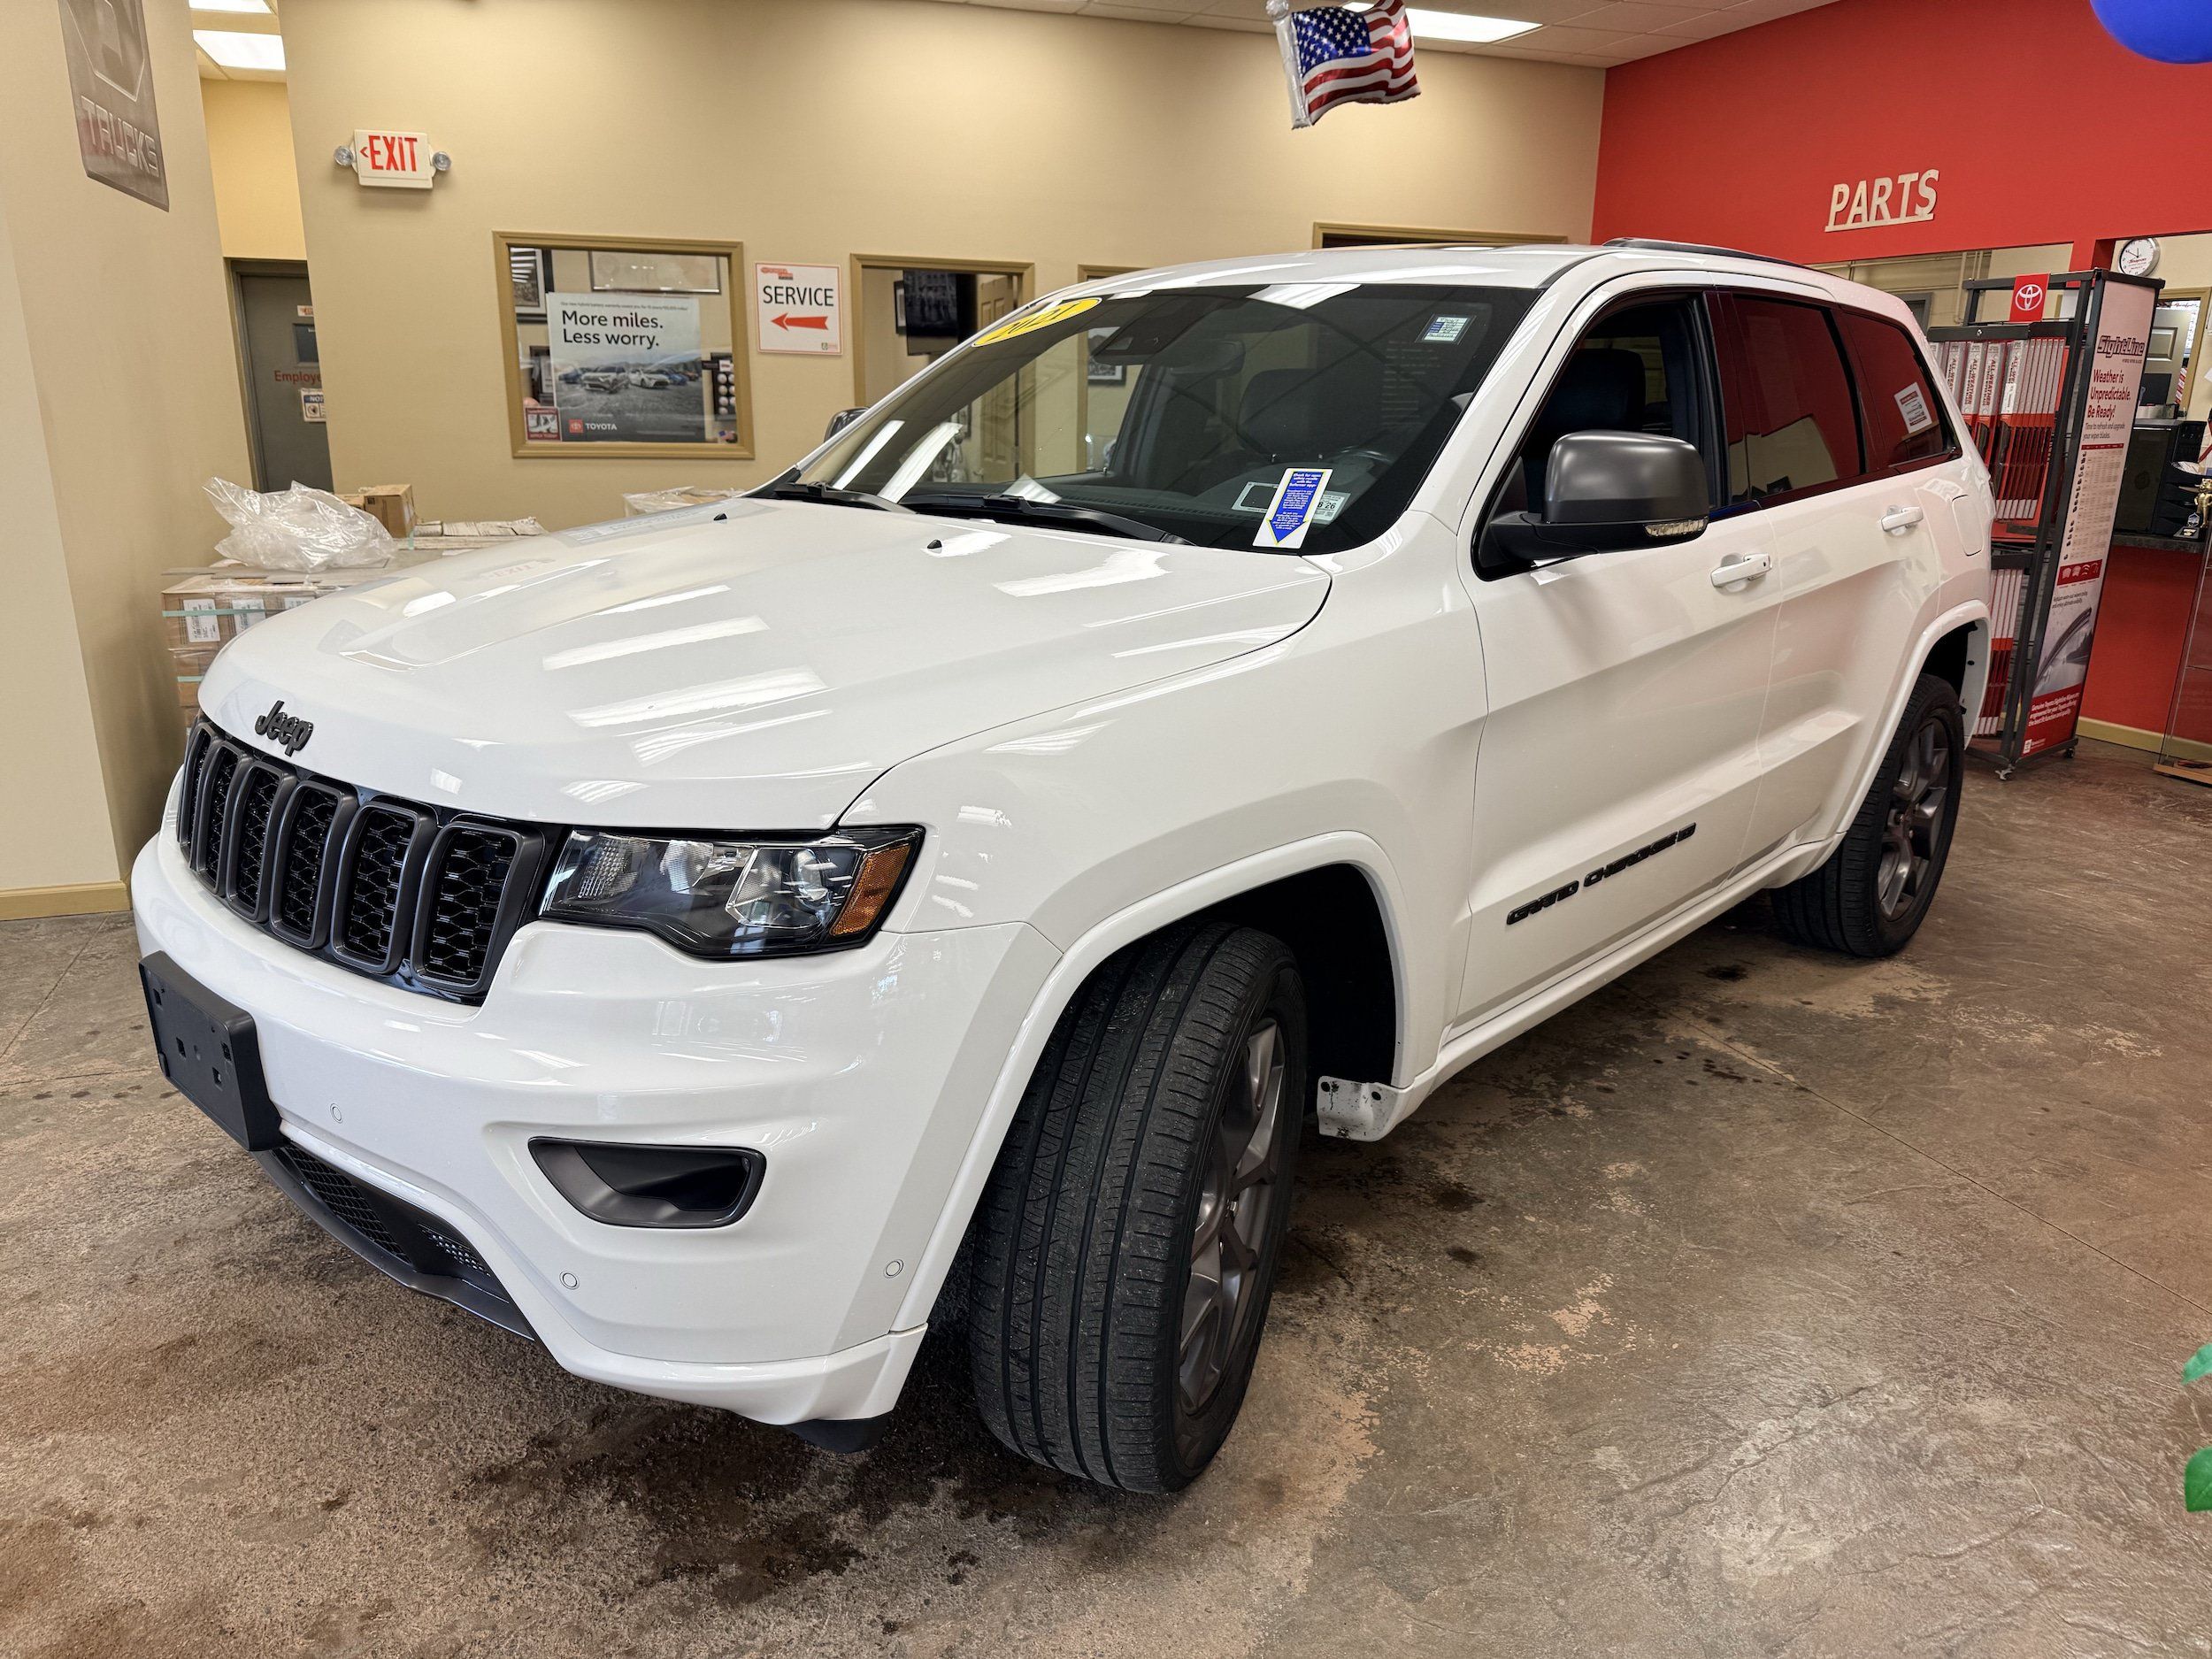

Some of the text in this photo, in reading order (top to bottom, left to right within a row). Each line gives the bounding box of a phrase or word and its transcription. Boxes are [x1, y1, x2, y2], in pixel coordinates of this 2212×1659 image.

[81, 95, 160, 178] TRUCKS
[367, 135, 419, 173] EXIT
[1826, 168, 1940, 230] PARTS
[762, 285, 833, 307] SERVICE
[562, 310, 664, 329] More miles.
[563, 328, 659, 349] Less worry.
[2096, 335, 2146, 358] SightLine
[1968, 358, 1978, 405] ALL-WEATHER
[1985, 359, 1996, 406] ALL-WEATHER
[2093, 369, 2124, 384] Weather is
[2090, 387, 2131, 403] Unpredictable.
[2086, 404, 2116, 421] Be Ready!
[585, 421, 618, 431] TOYOTA
[255, 700, 314, 757] Jeep
[1506, 879, 1579, 926] GRAND
